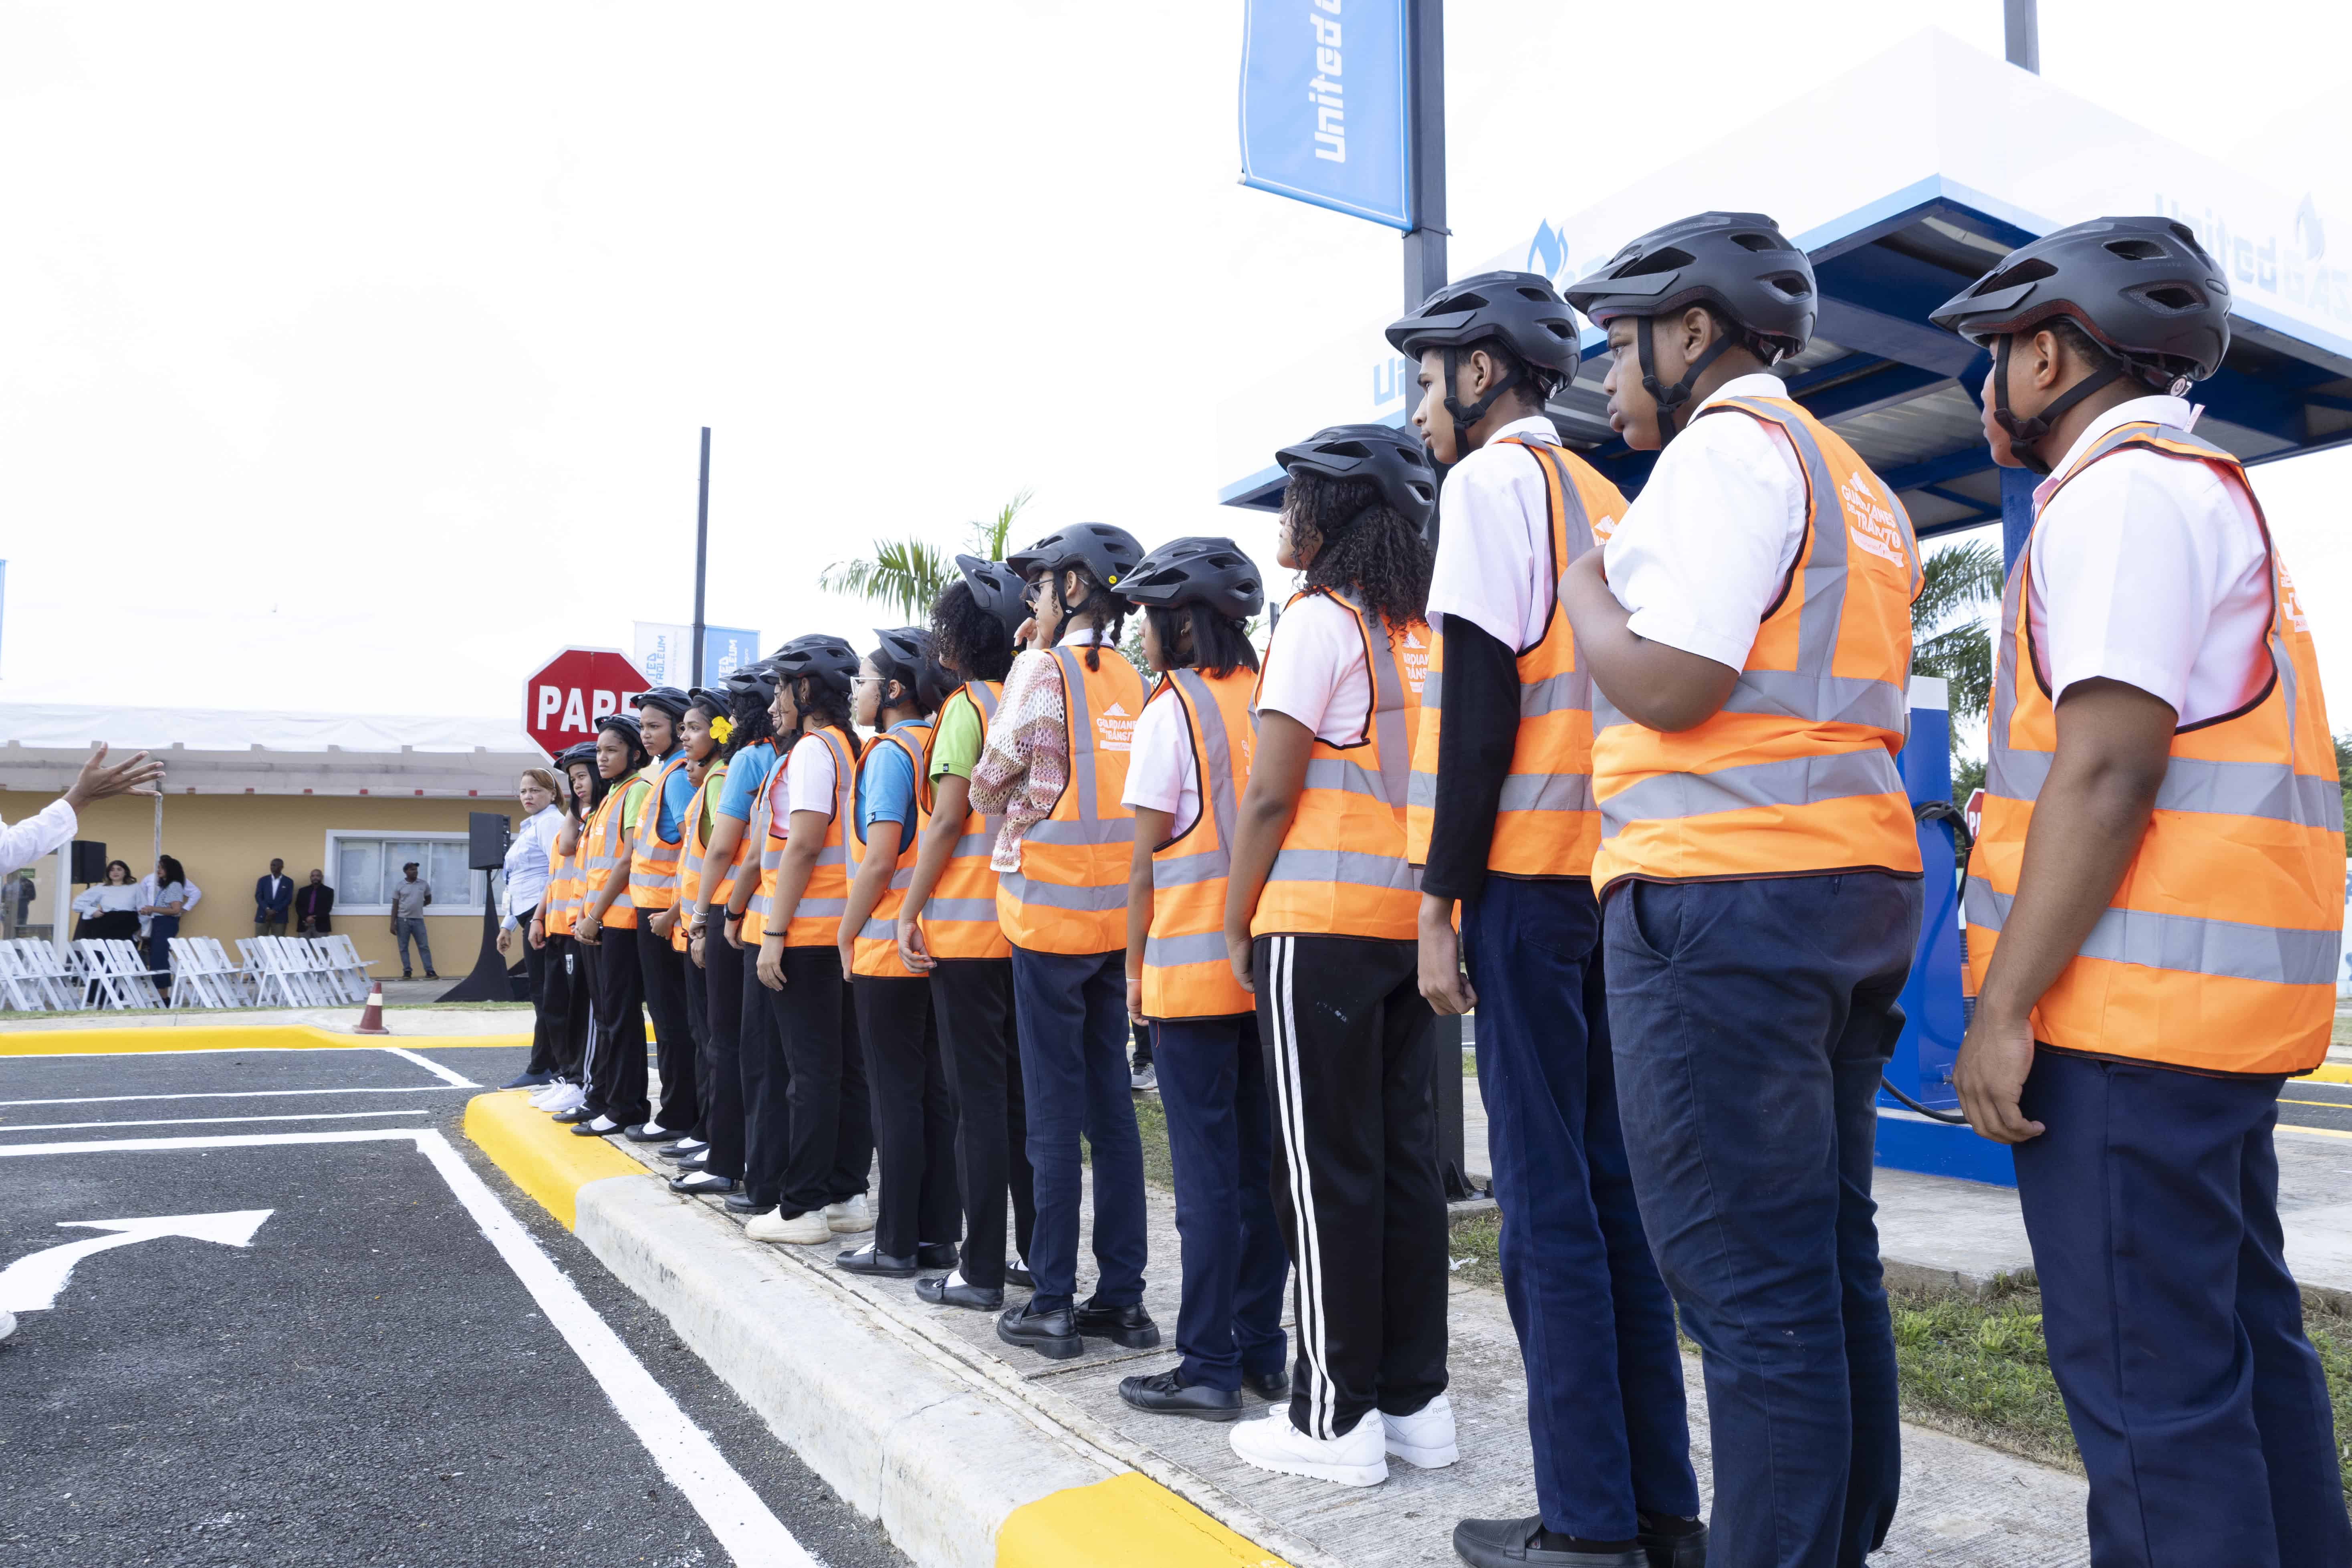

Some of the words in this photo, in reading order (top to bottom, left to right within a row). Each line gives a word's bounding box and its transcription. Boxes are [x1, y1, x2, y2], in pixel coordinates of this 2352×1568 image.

[645, 653, 656, 677] TED
[655, 635, 666, 685] TROLEUM
[1432, 1405, 1449, 1414] Reeb
